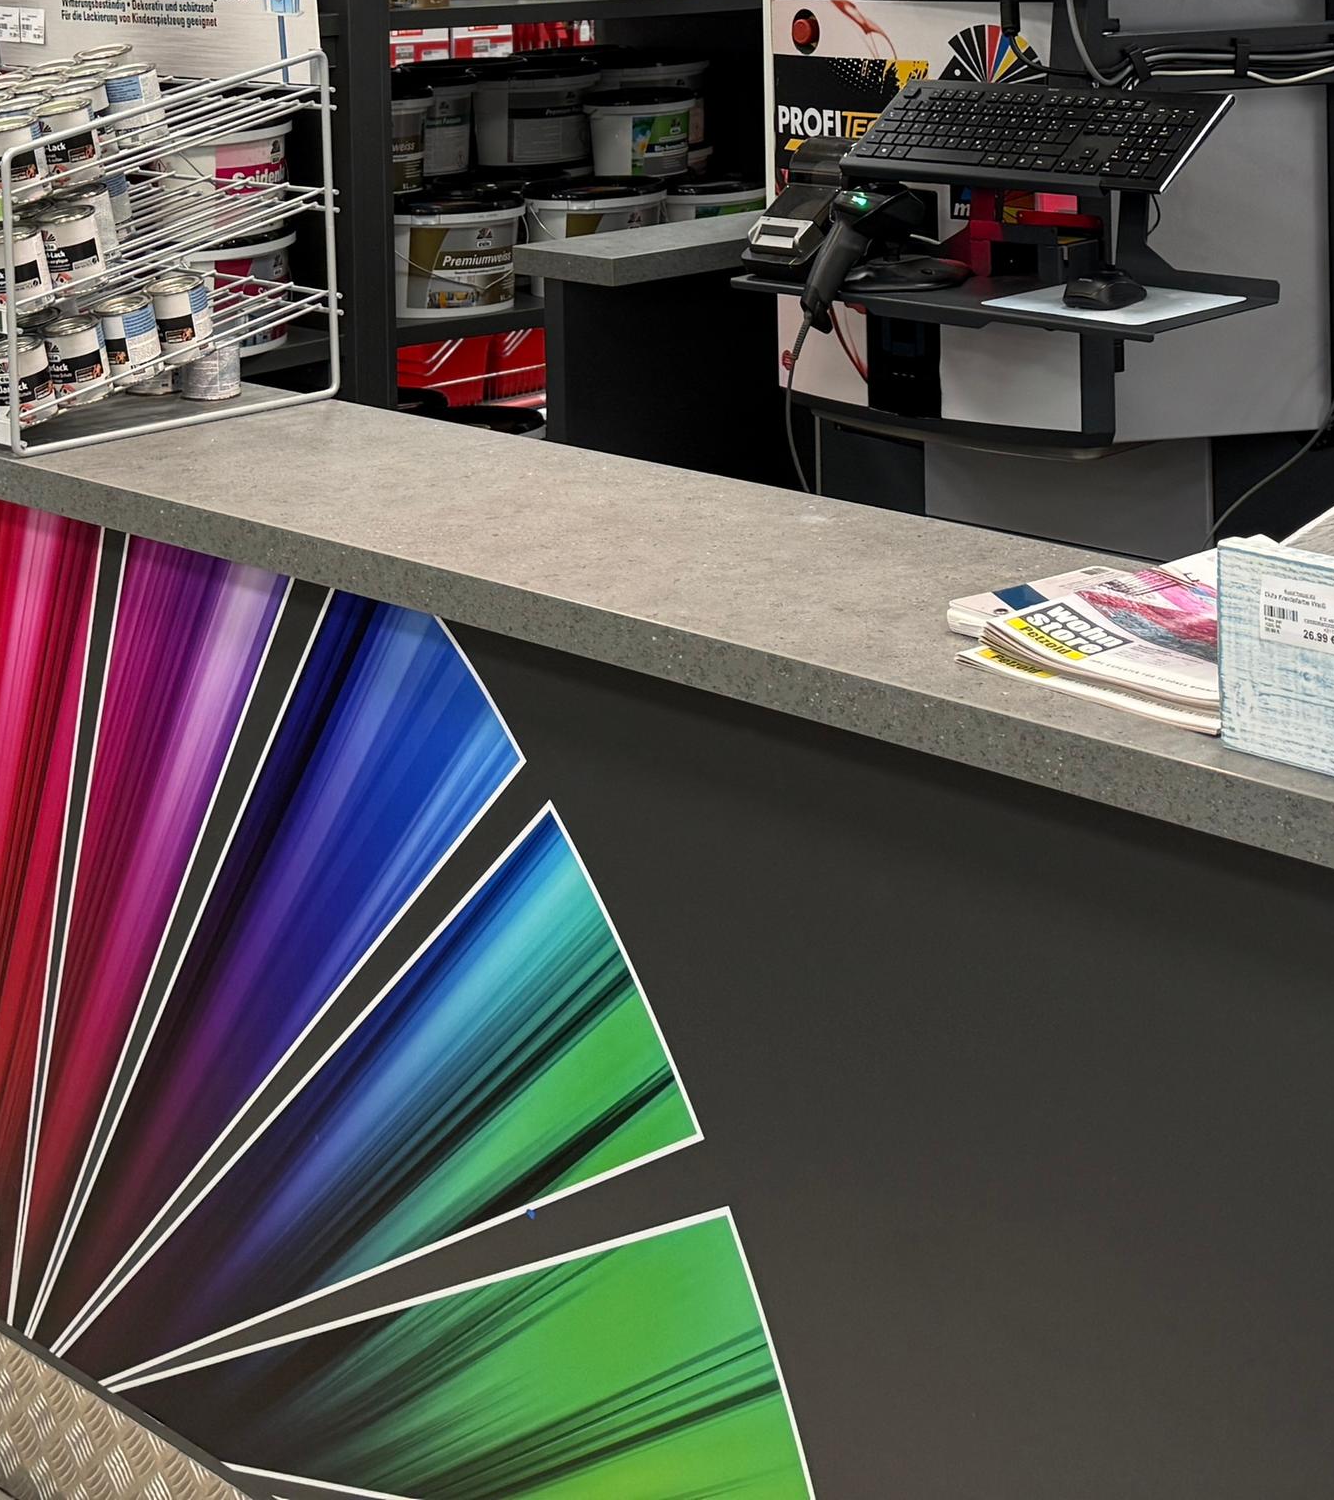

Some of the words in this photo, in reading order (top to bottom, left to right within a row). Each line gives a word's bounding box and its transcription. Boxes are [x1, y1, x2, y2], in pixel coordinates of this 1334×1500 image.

[131, 0, 163, 11] Dekorativ
[165, 2, 178, 12] und
[179, 1, 213, 13] schützend
[62, 10, 71, 20] Für
[73, 11, 82, 21] die
[83, 11, 118, 25] Lackierung
[119, 15, 131, 23] von
[132, 13, 185, 27] Kinderspielzeug
[186, 16, 217, 29] geeignet
[442, 250, 512, 268] Premiumweiss
[1027, 612, 1103, 655] store
[1046, 604, 1125, 648] wohn
[1303, 629, 1328, 644] 26.99
